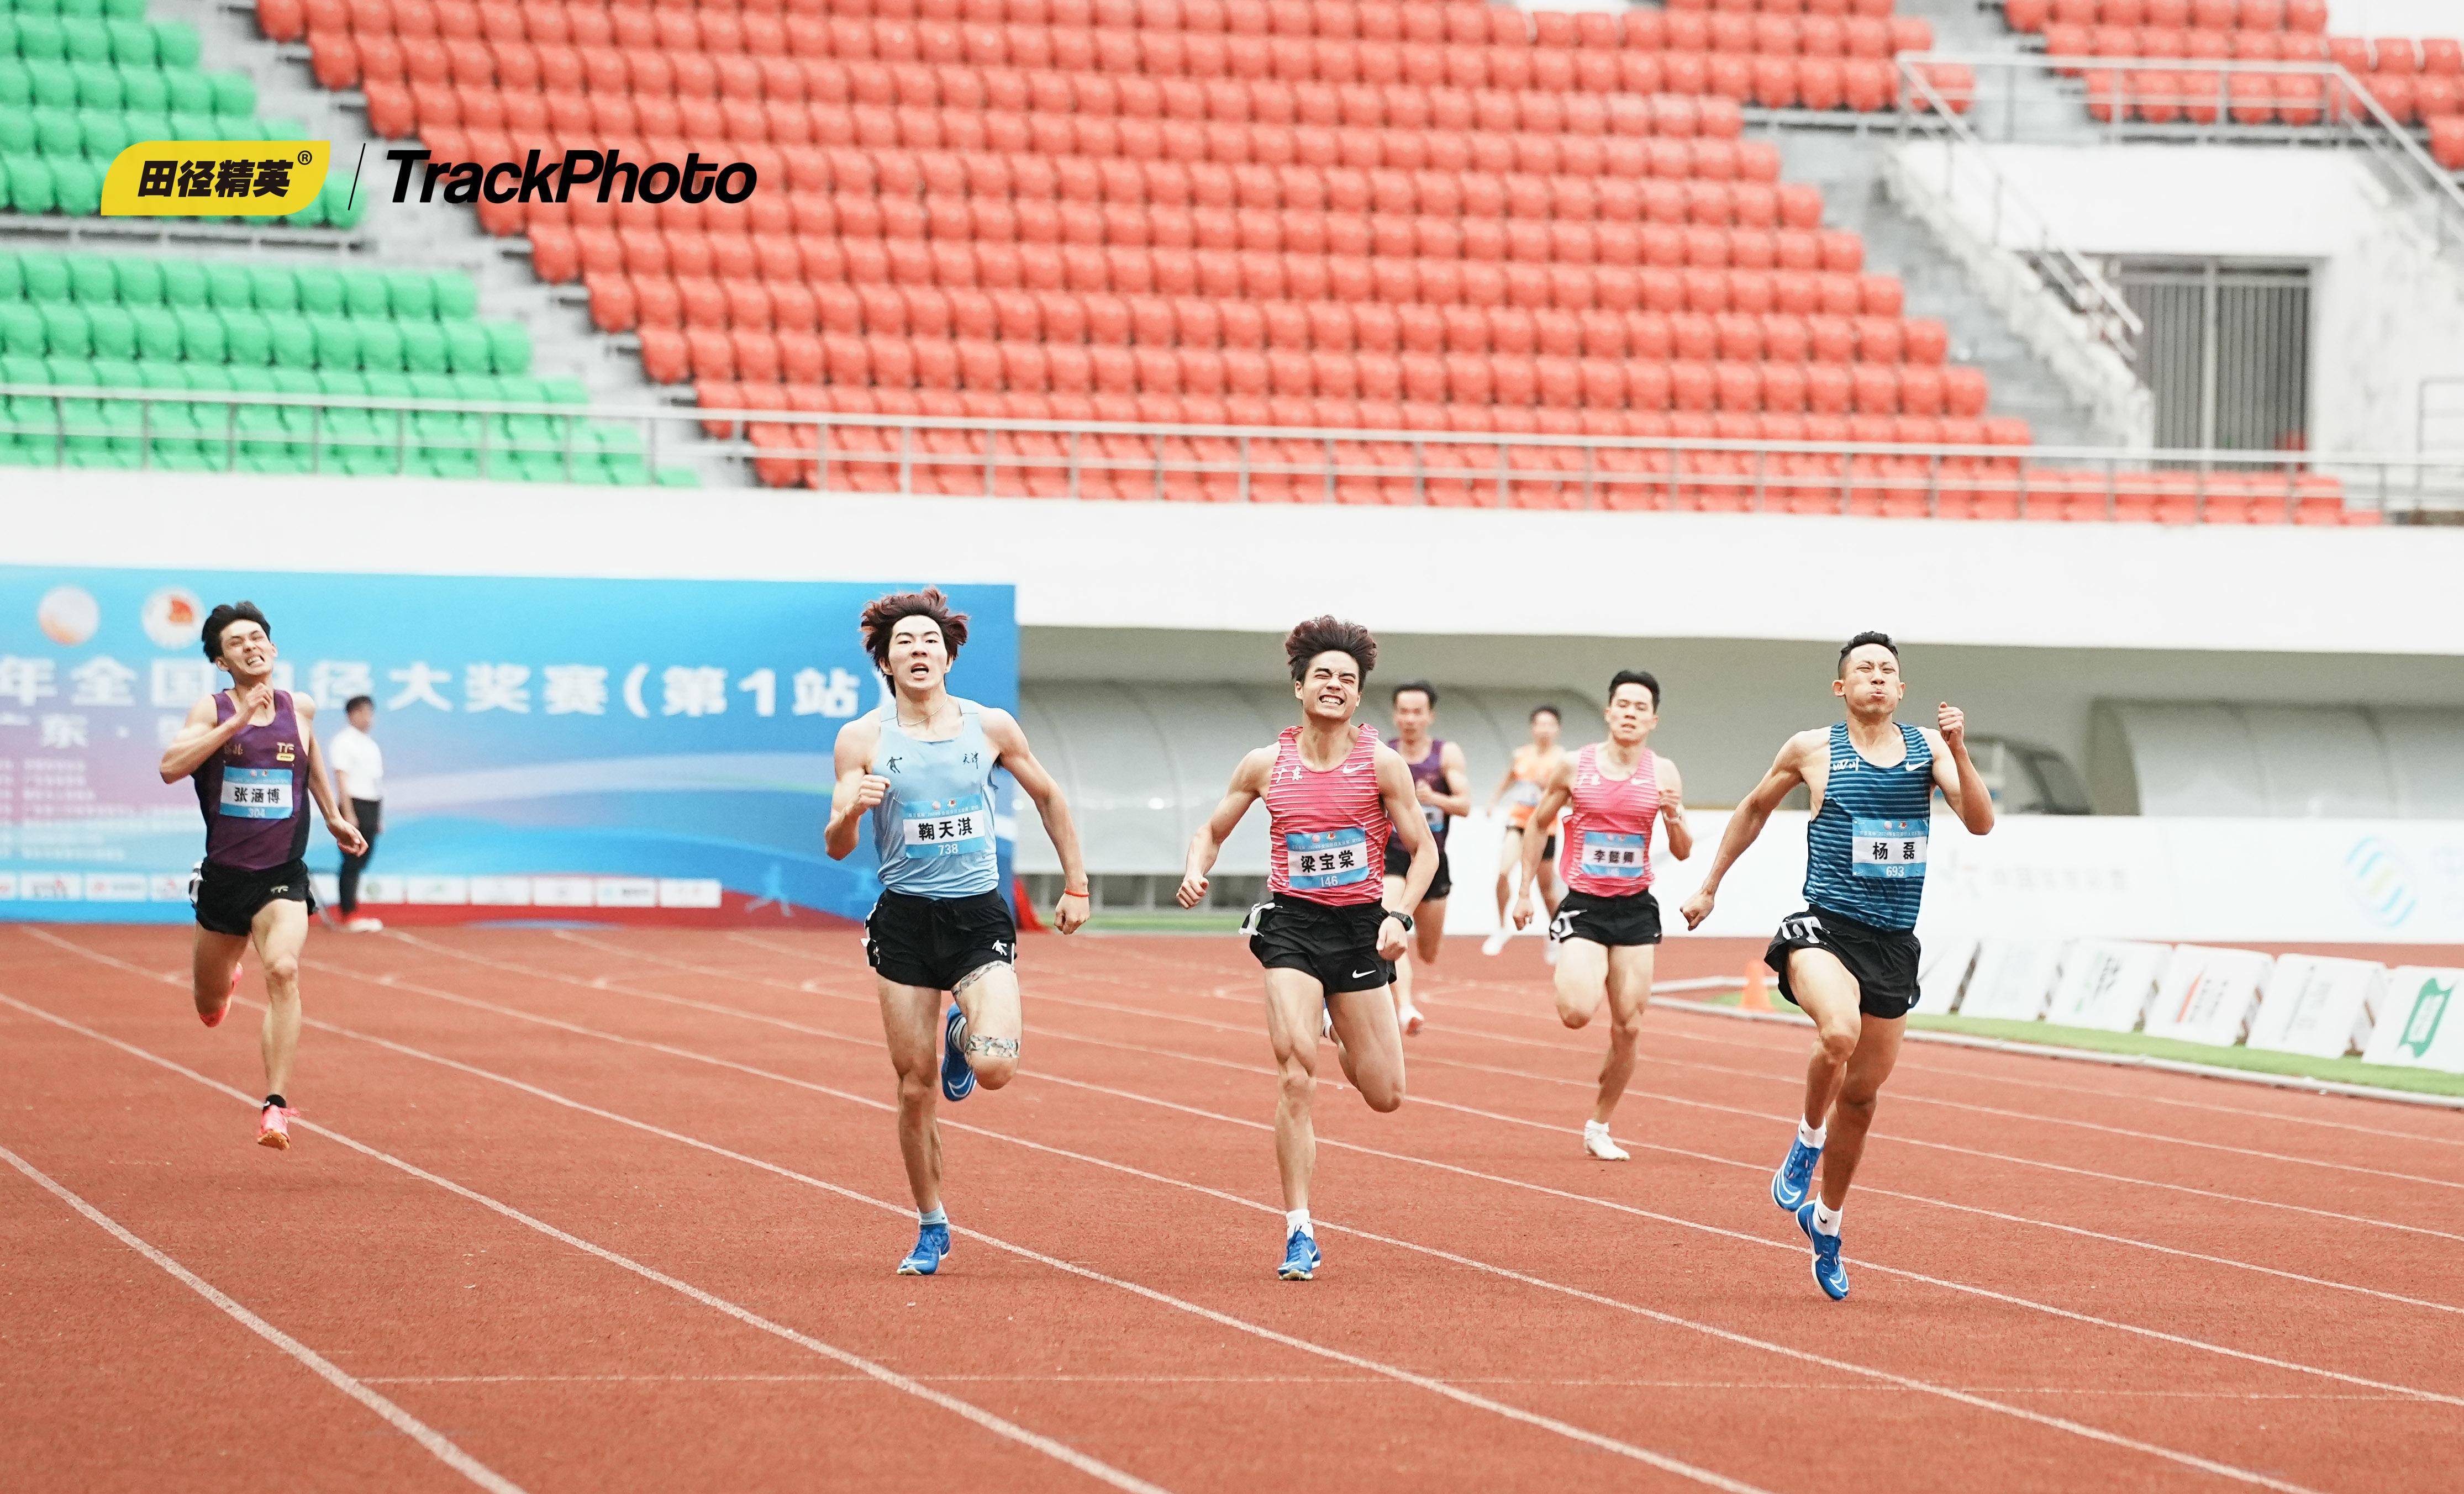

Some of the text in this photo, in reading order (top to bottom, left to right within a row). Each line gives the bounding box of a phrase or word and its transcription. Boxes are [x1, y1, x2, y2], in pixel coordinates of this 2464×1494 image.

[1274, 766, 1303, 784] 广东
[234, 787, 281, 804] 张涵博
[918, 817, 972, 841] 鞠天淇
[938, 843, 959, 856] 738
[1301, 849, 1355, 873] 梁宝棠
[1886, 865, 1905, 877] 693
[1320, 875, 1339, 887] 146
